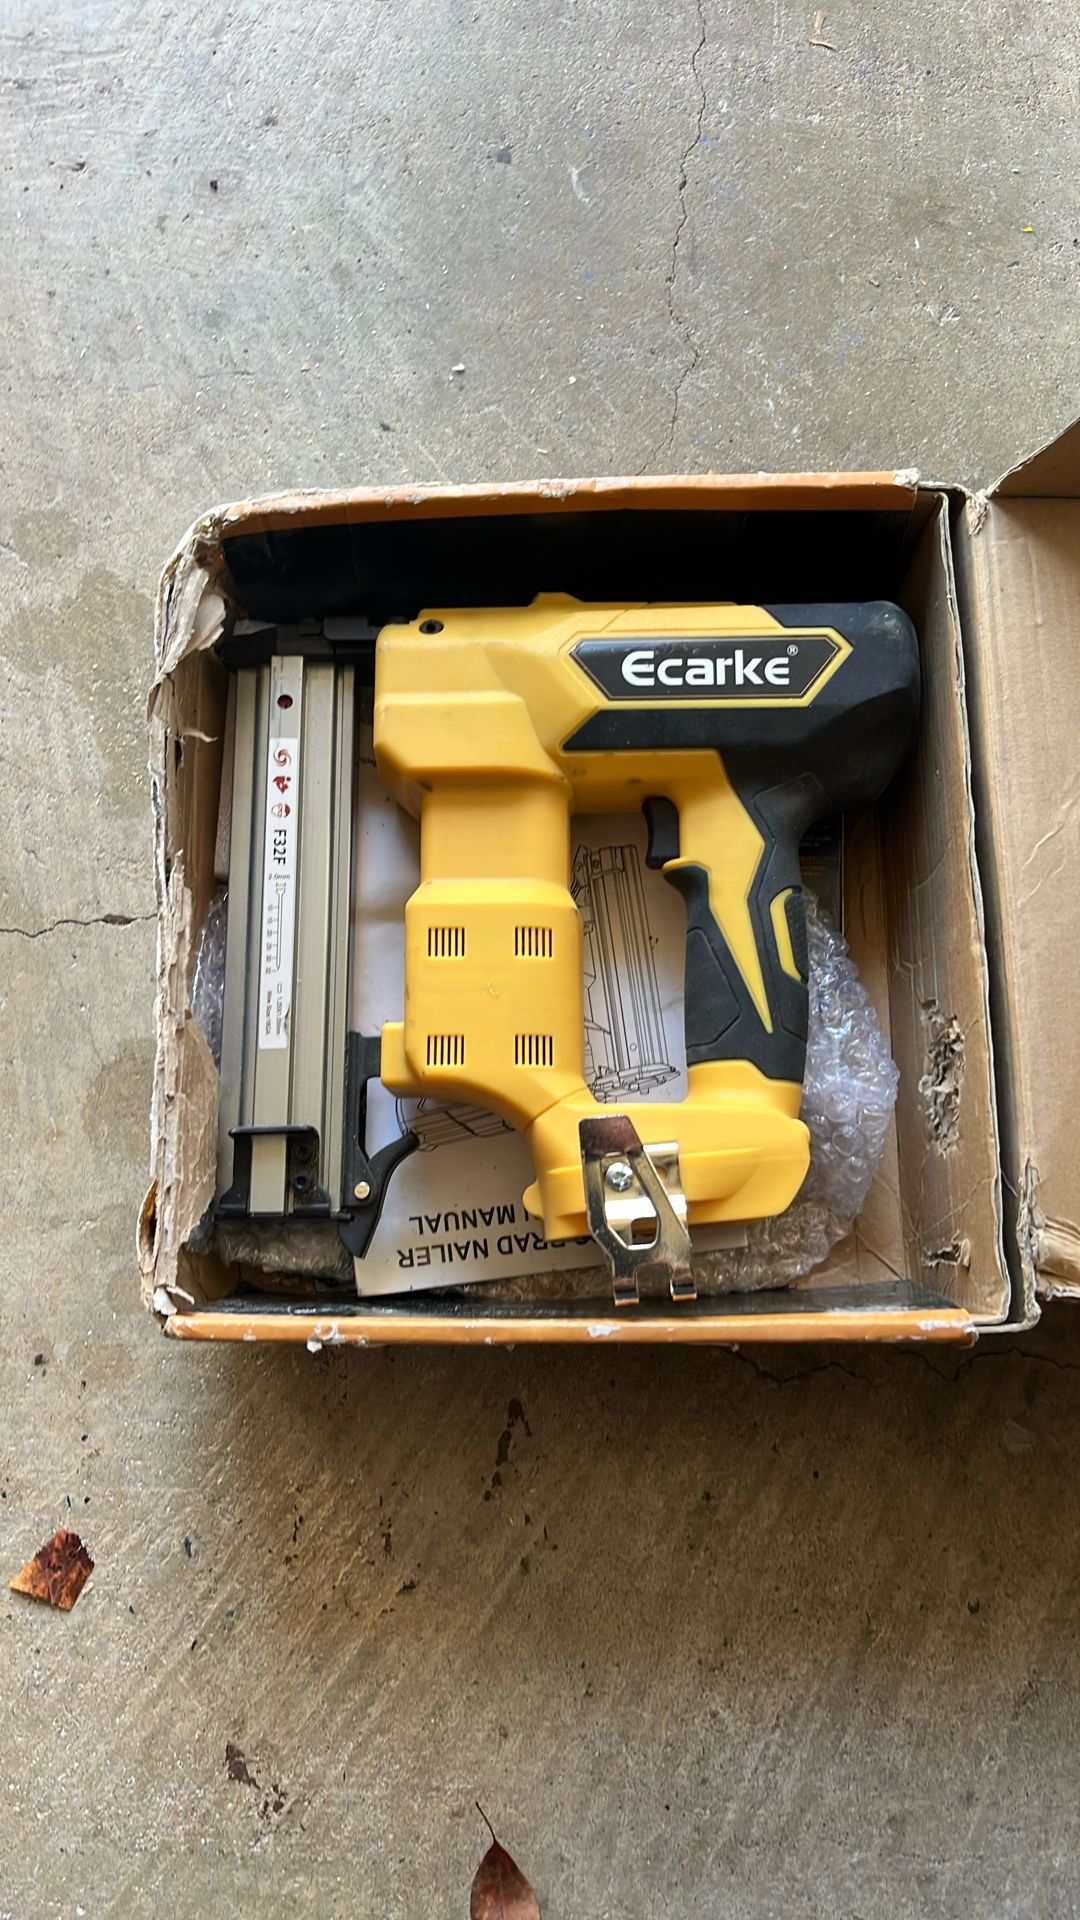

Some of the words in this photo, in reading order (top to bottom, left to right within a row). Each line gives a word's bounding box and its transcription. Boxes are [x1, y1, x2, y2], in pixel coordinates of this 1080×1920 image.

[273, 829, 287, 865] F32F
[408, 1204, 516, 1235] MANUAL
[396, 1238, 489, 1268] NAILER
